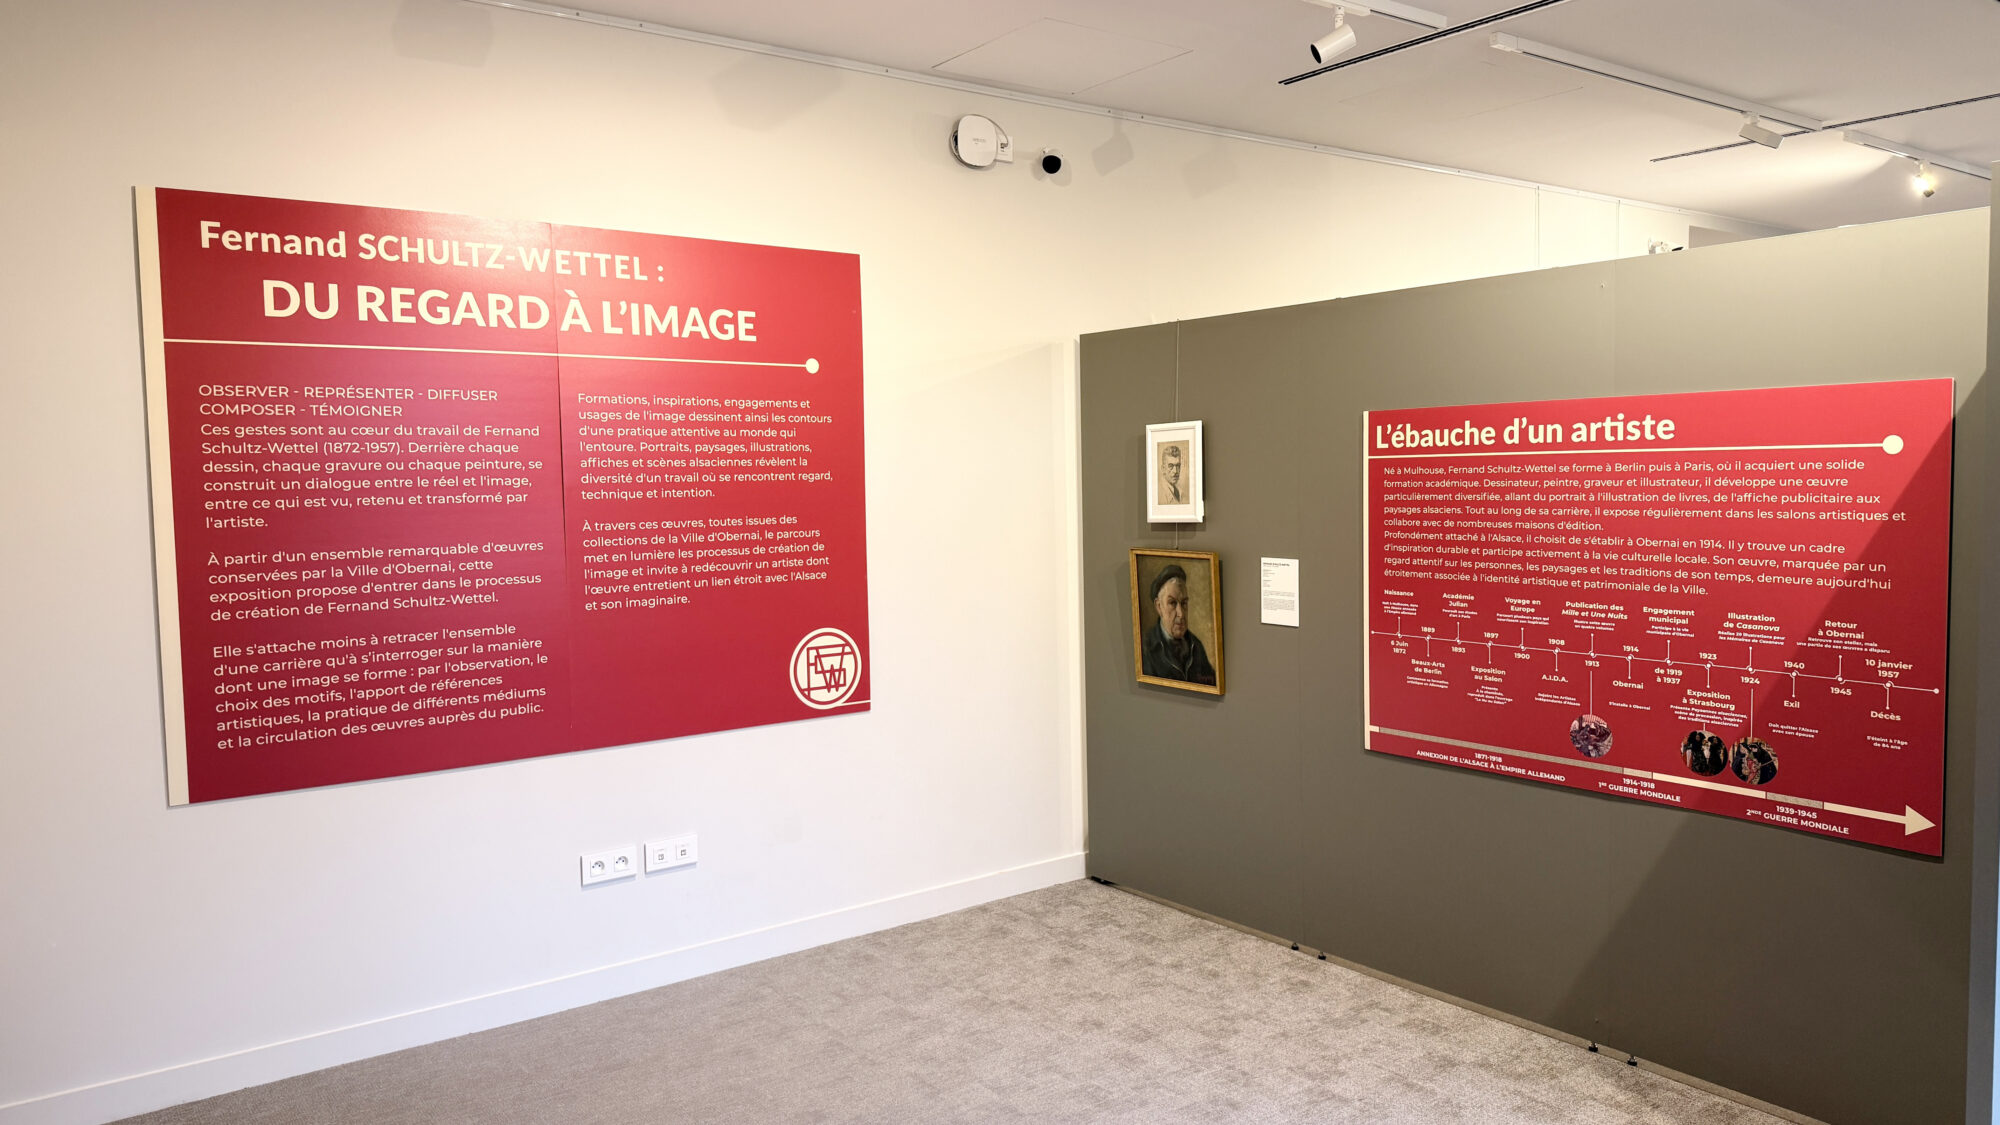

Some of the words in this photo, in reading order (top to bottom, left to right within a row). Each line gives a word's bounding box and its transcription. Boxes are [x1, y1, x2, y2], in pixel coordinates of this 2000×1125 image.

[200, 220, 347, 258] Fernand
[358, 233, 648, 281] SCHULTZ-WETTEL
[263, 280, 339, 320] DU
[357, 285, 550, 330] REGARD
[560, 288, 593, 333] À
[602, 300, 757, 342] L’IMAGE
[199, 384, 289, 397] OBSERVER
[304, 385, 414, 399] REPRÉSENTER
[428, 389, 498, 401] DIFFUSER
[578, 393, 650, 407] Formations,
[653, 394, 722, 408] inspirations,
[724, 399, 798, 410] engagements
[800, 400, 810, 408] et
[200, 403, 295, 416] COMPOSER
[309, 402, 402, 416] TÉMOIGNER
[1376, 420, 1496, 449] L’ébauche
[1503, 417, 1563, 445] d’un
[1571, 413, 1675, 443] artiste
[202, 442, 318, 454] Schultz-Wettel
[323, 442, 404, 456] (1872-1957).
[408, 441, 465, 453] Derrière
[468, 442, 519, 455] chaque
[580, 441, 636, 452] l'entoure.
[640, 442, 692, 453] Portraits,
[695, 444, 748, 454] paysages,
[750, 442, 812, 453] illustrations,
[1384, 518, 1421, 526] collabore
[1443, 519, 1455, 527] de
[1457, 519, 1513, 528] nombreuses
[1515, 520, 1555, 530] maisons
[1557, 521, 1604, 530] d'édition.
[208, 552, 220, 566] À
[224, 552, 268, 568] partir
[272, 551, 306, 563] d'un
[310, 546, 384, 561] ensemble
[388, 543, 479, 557] remarquable
[482, 542, 544, 553] d'œuvres
[1384, 568, 1432, 579] étroitement
[1434, 572, 1470, 581] associée
[1472, 573, 1478, 582] à
[1480, 573, 1520, 584] l'identité
[1522, 576, 1569, 588] artistique
[1571, 580, 1581, 588] et
[1584, 580, 1650, 592] patrimoniale
[1653, 583, 1667, 593] de
[1670, 584, 1679, 593] la
[1682, 585, 1708, 595] Ville.
[210, 609, 231, 621] de
[235, 605, 300, 619] création
[304, 603, 323, 615] de
[328, 598, 389, 613] Fernand
[393, 592, 499, 609] Schultz-Wettel.
[585, 601, 598, 611] et
[601, 601, 622, 610] son
[626, 594, 690, 608] imaginaire.
[1565, 601, 1608, 610] Publication
[1643, 606, 1695, 616] Engagement
[1728, 612, 1776, 622] Illustration
[1649, 616, 1689, 625] municipal
[1825, 620, 1858, 629] Retour
[1736, 622, 1780, 632] Casanova
[1826, 630, 1864, 639] Obernai
[1699, 652, 1717, 660] 1923
[1784, 660, 1805, 669] 1940
[1865, 658, 1876, 666] 10
[1877, 659, 1913, 670] janvier
[1541, 674, 1569, 683] A.I.D.A.
[1740, 676, 1760, 684] 1924
[1878, 670, 1900, 678] 1957
[1612, 680, 1644, 689] Obernai
[1687, 689, 1731, 700] Exposition
[1830, 686, 1852, 696] 1945
[1689, 698, 1735, 710] Strasbourg
[1783, 700, 1800, 708] Exil
[1870, 710, 1901, 721] Décès
[217, 738, 234, 749] et
[238, 736, 251, 747] la
[256, 727, 337, 745] circulation
[341, 723, 367, 735] des
[371, 718, 425, 732] œuvres
[428, 711, 475, 726] auprès
[478, 708, 496, 719] du
[500, 702, 544, 719] public.
[1416, 750, 1448, 761] ANNEXION
[1459, 758, 1488, 768] L'ALSACE
[1496, 764, 1526, 775] L'EMPIRE
[1527, 770, 1566, 782] ALLEMAND
[1623, 778, 1655, 789] 1914-1918
[1608, 784, 1638, 795] GUERRE
[1640, 790, 1681, 802] MONDIALE
[1776, 805, 1817, 819] 1939-1945
[1763, 812, 1798, 825] GUERRE
[1800, 818, 1849, 834] MONDIALE
